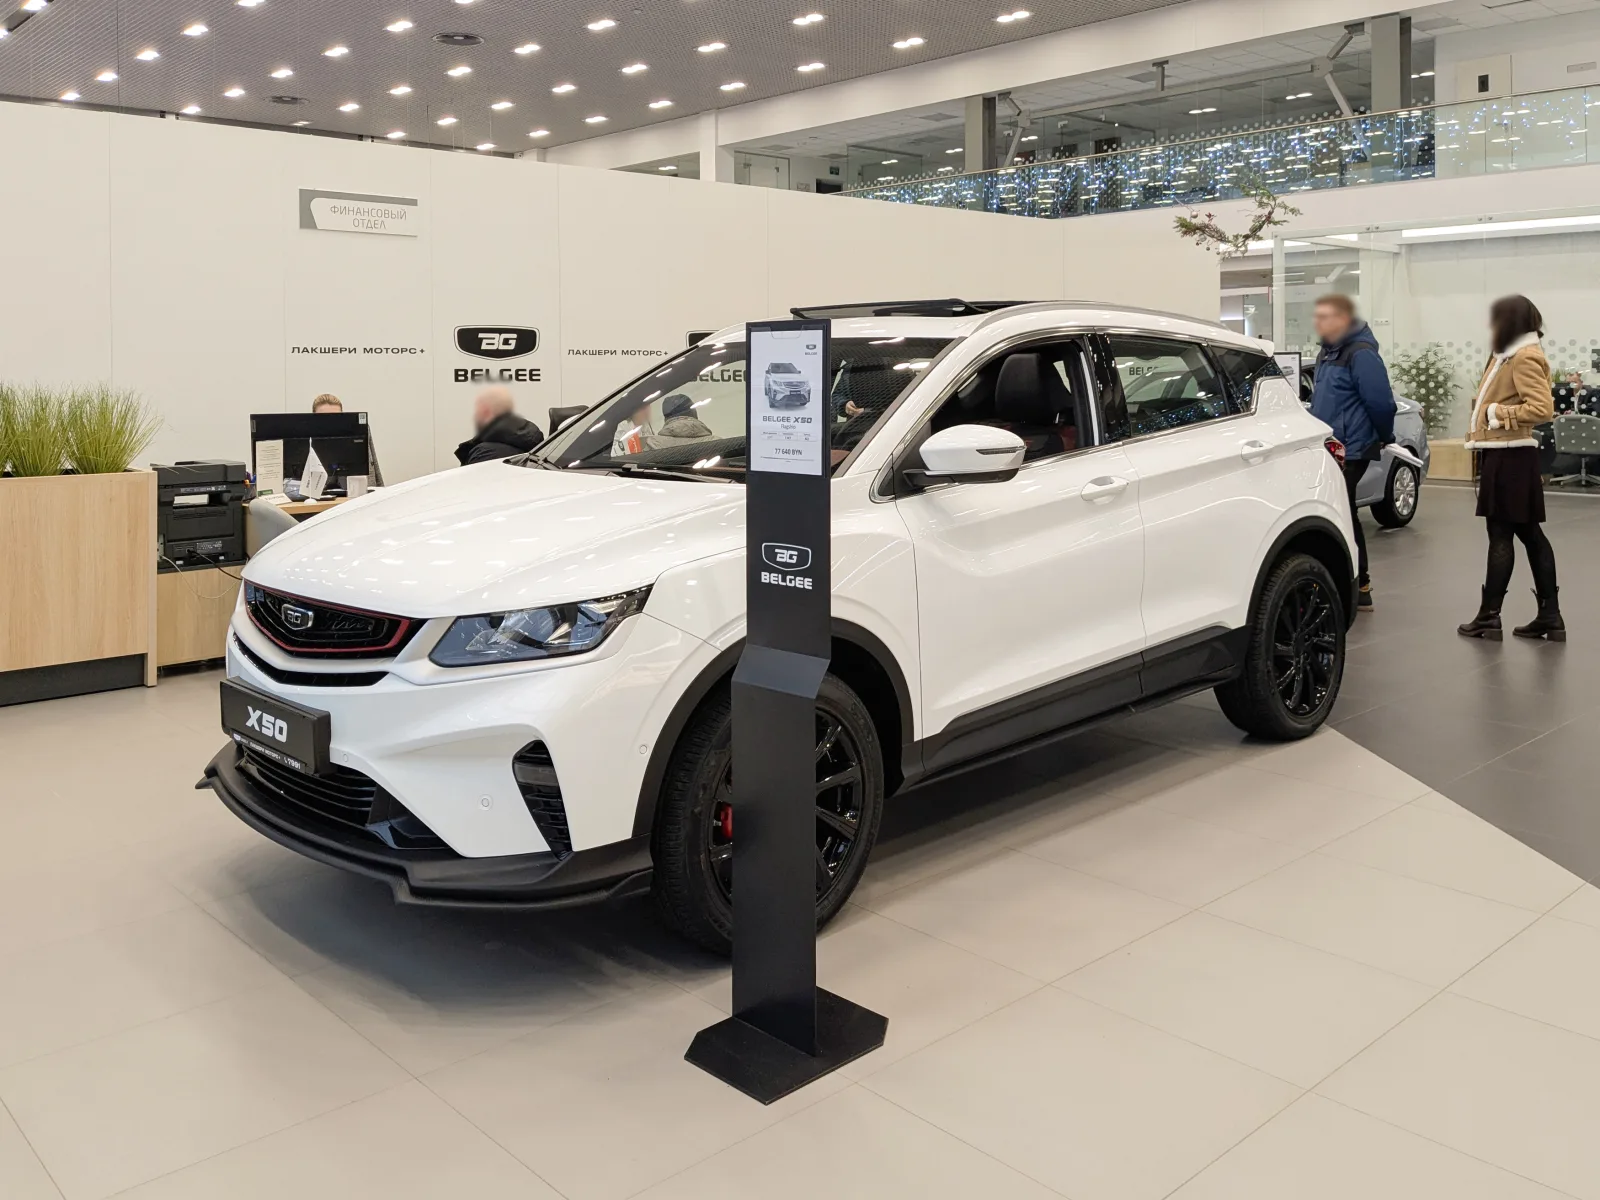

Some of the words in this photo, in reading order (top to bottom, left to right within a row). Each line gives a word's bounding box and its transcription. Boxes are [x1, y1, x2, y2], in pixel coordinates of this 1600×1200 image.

[330, 205, 407, 220] ФИНАНСОВЫЙ
[352, 217, 387, 230] ОТДЕЛ
[291, 346, 357, 354] ЛАКШЕРИ
[762, 415, 791, 423] BELGEE
[793, 416, 813, 424] X50
[774, 447, 781, 455] 77
[761, 571, 812, 590] BELGEE
[245, 705, 288, 743] X50
